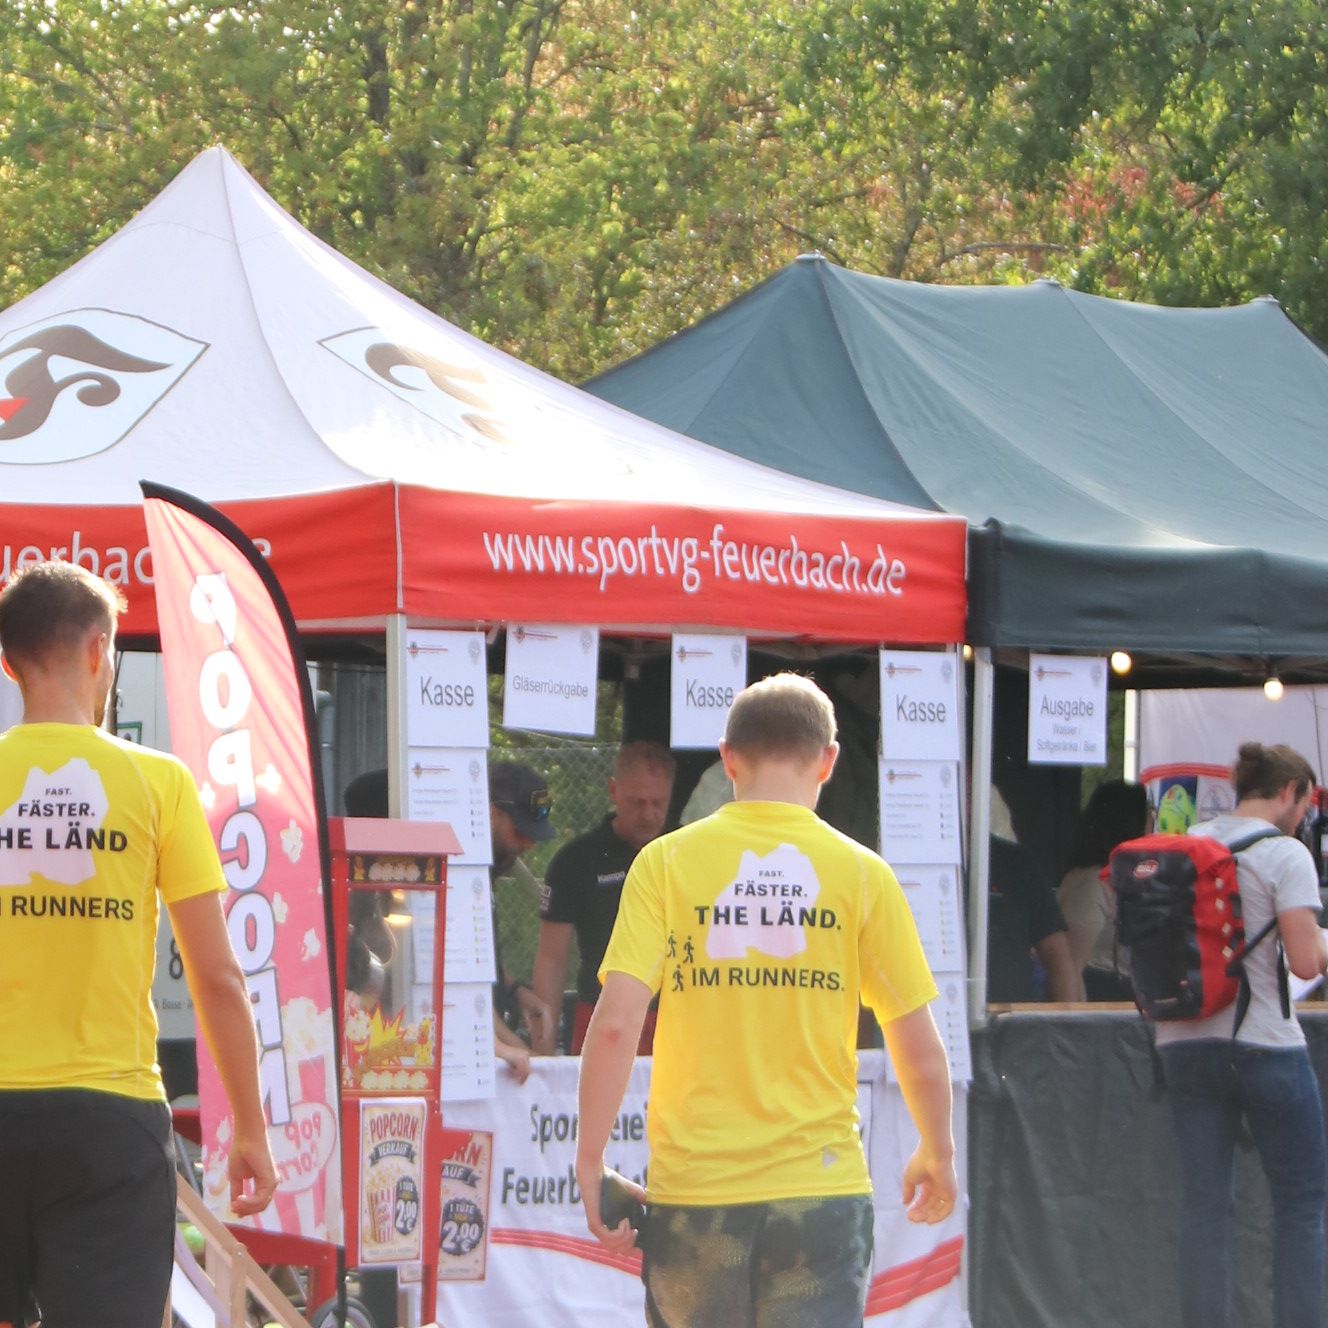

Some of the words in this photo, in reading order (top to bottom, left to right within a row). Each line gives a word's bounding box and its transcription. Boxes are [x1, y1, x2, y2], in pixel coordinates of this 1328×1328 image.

[483, 523, 907, 595] www.sportvg-feuerbach.de
[420, 675, 475, 708] Kasse
[512, 674, 589, 700] Gläserrückgabe
[685, 678, 734, 708] Kasse
[895, 694, 947, 723] Kasse
[1039, 694, 1095, 722] Ausgabe
[44, 787, 72, 797] FAST.
[18, 799, 96, 818] FÄSTER.
[45, 821, 128, 853] LÄND
[733, 879, 808, 898] FÄSTER.
[11, 895, 135, 922] RUNNERS
[694, 905, 749, 926] THE
[760, 900, 843, 932] LÄND.
[691, 967, 721, 988] IM
[728, 967, 846, 993] RUNNERS.
[369, 1111, 419, 1143] POPCORN
[377, 1141, 409, 1157] VERKAUF
[501, 1163, 582, 1204] Feuerb
